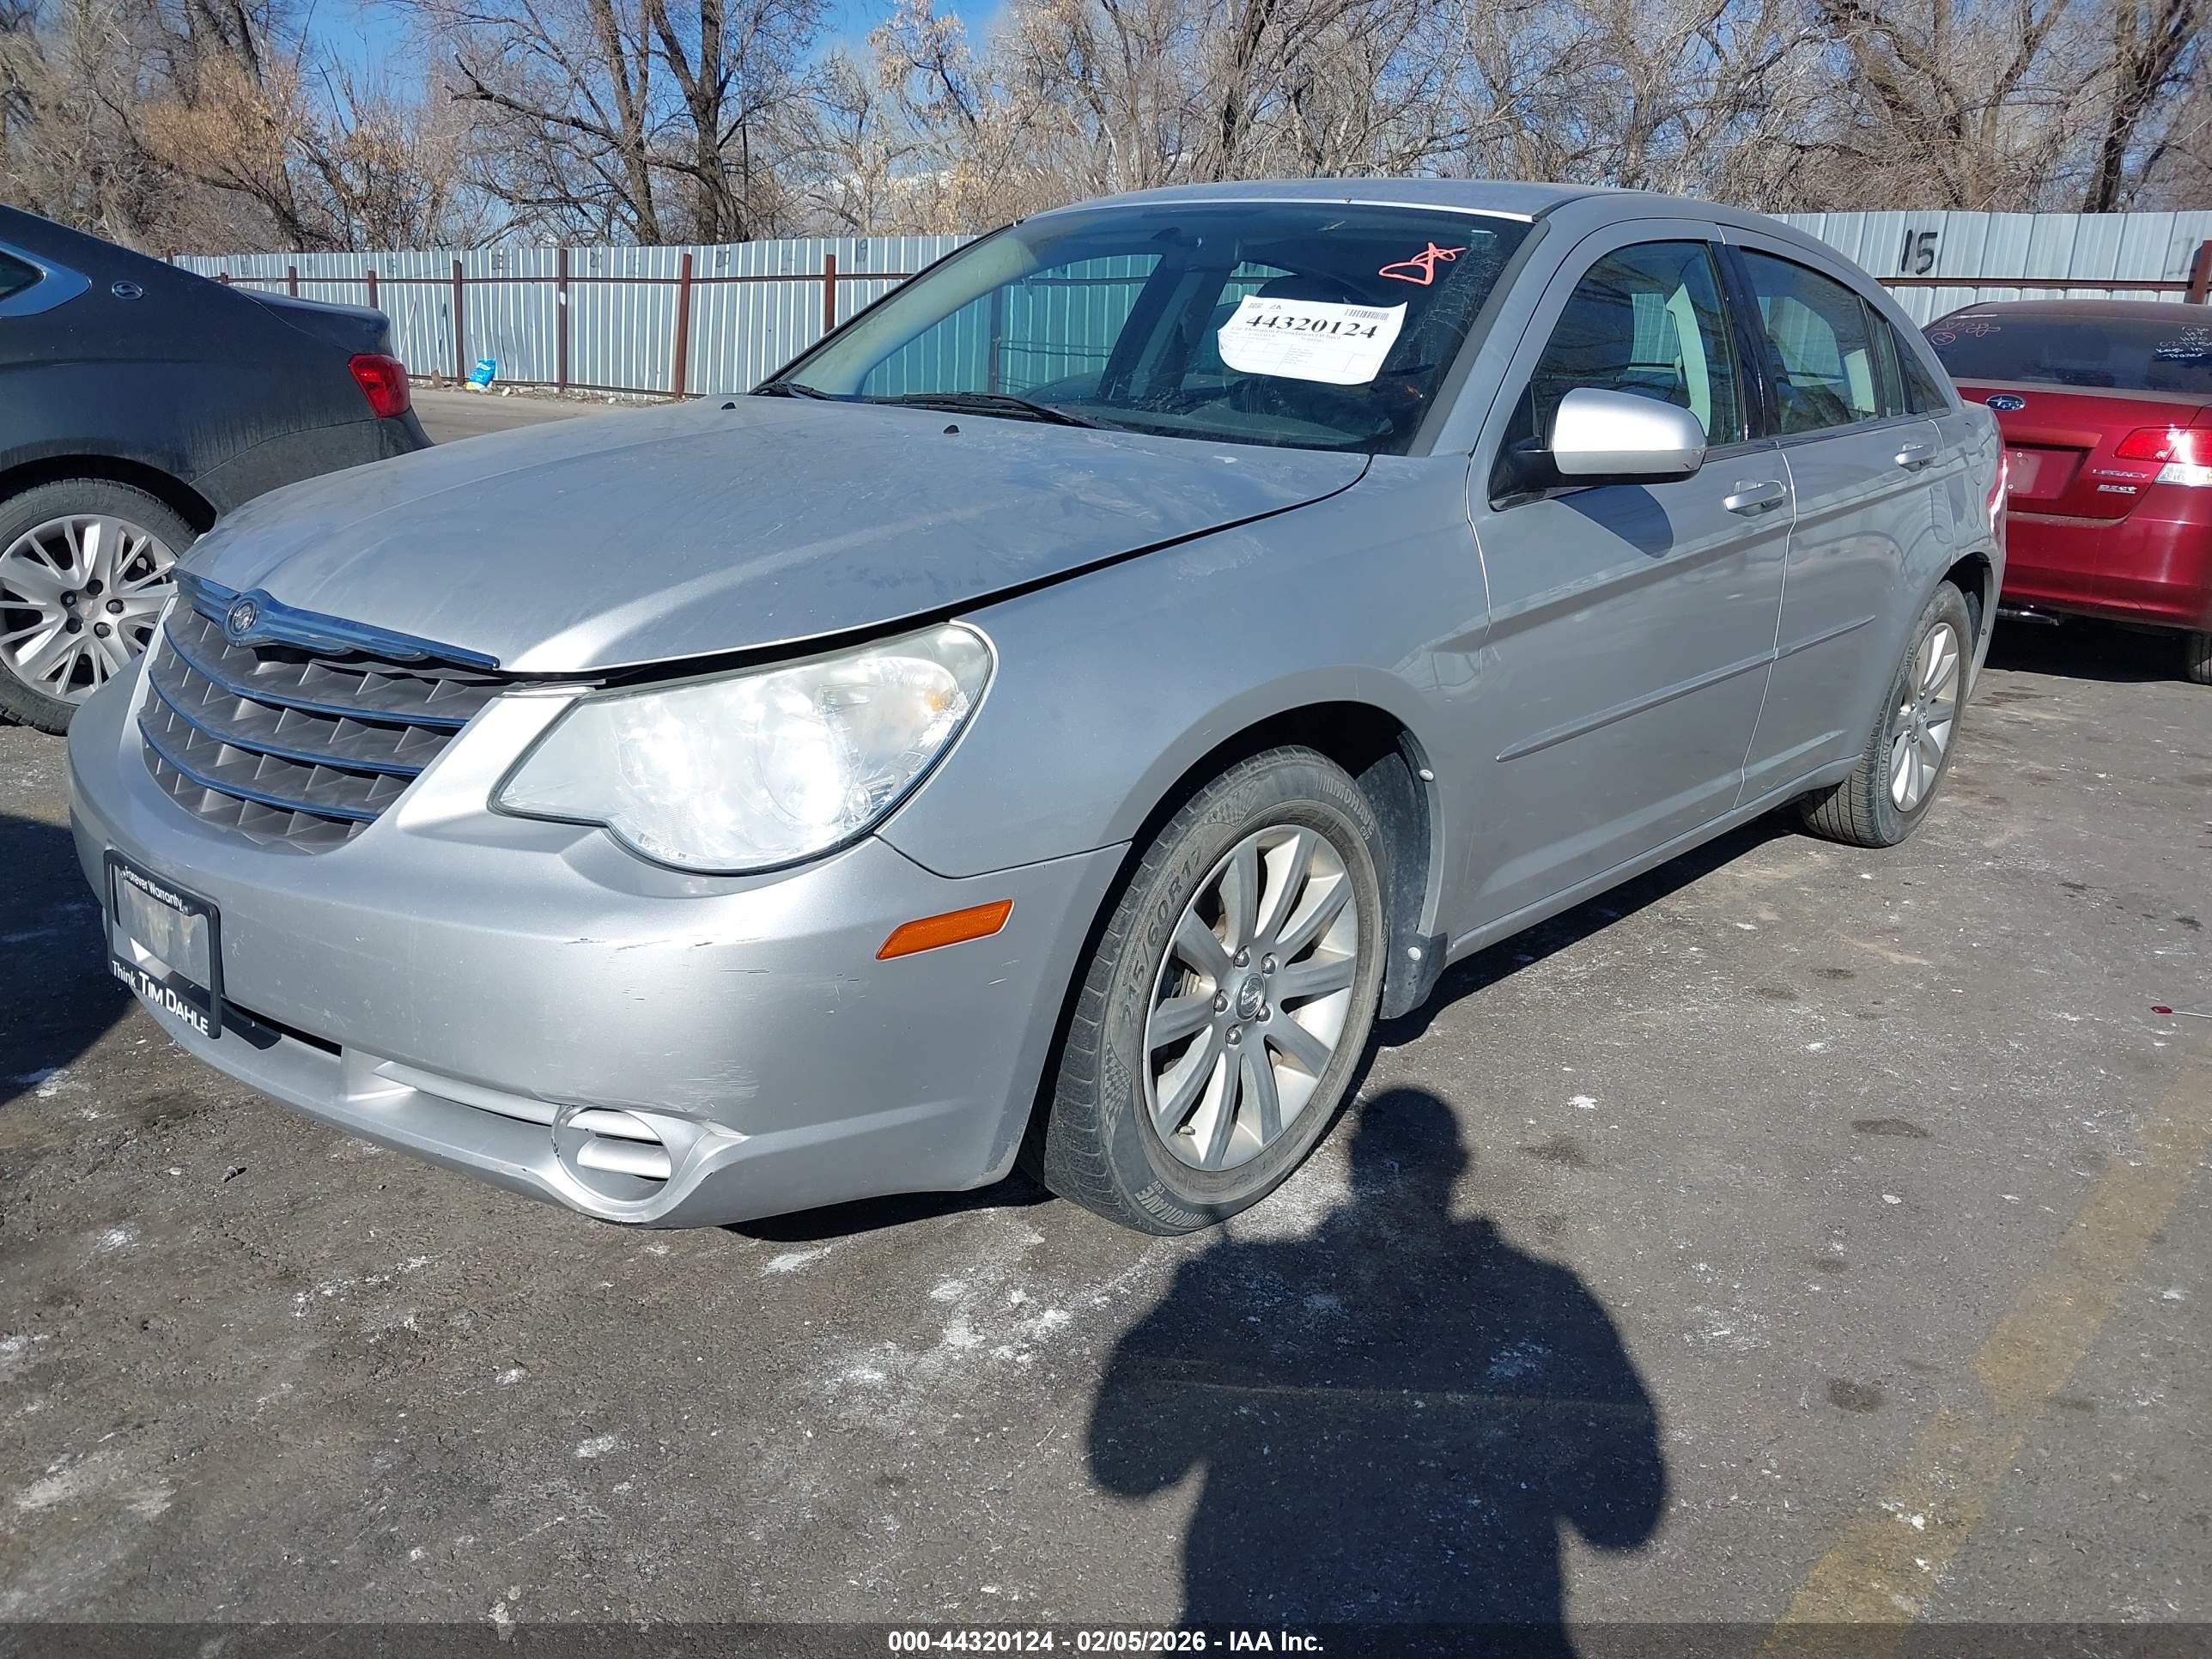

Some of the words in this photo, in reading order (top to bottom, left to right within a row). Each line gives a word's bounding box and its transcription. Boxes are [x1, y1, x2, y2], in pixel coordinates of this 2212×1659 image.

[855, 240, 869, 263] 19
[1901, 229, 1938, 276] 15
[1246, 313, 1378, 339] 44320124
[2091, 469, 2149, 479] LEGACY
[112, 960, 137, 988] Think
[138, 971, 164, 1006] TIM
[165, 988, 210, 1036] DAHLE
